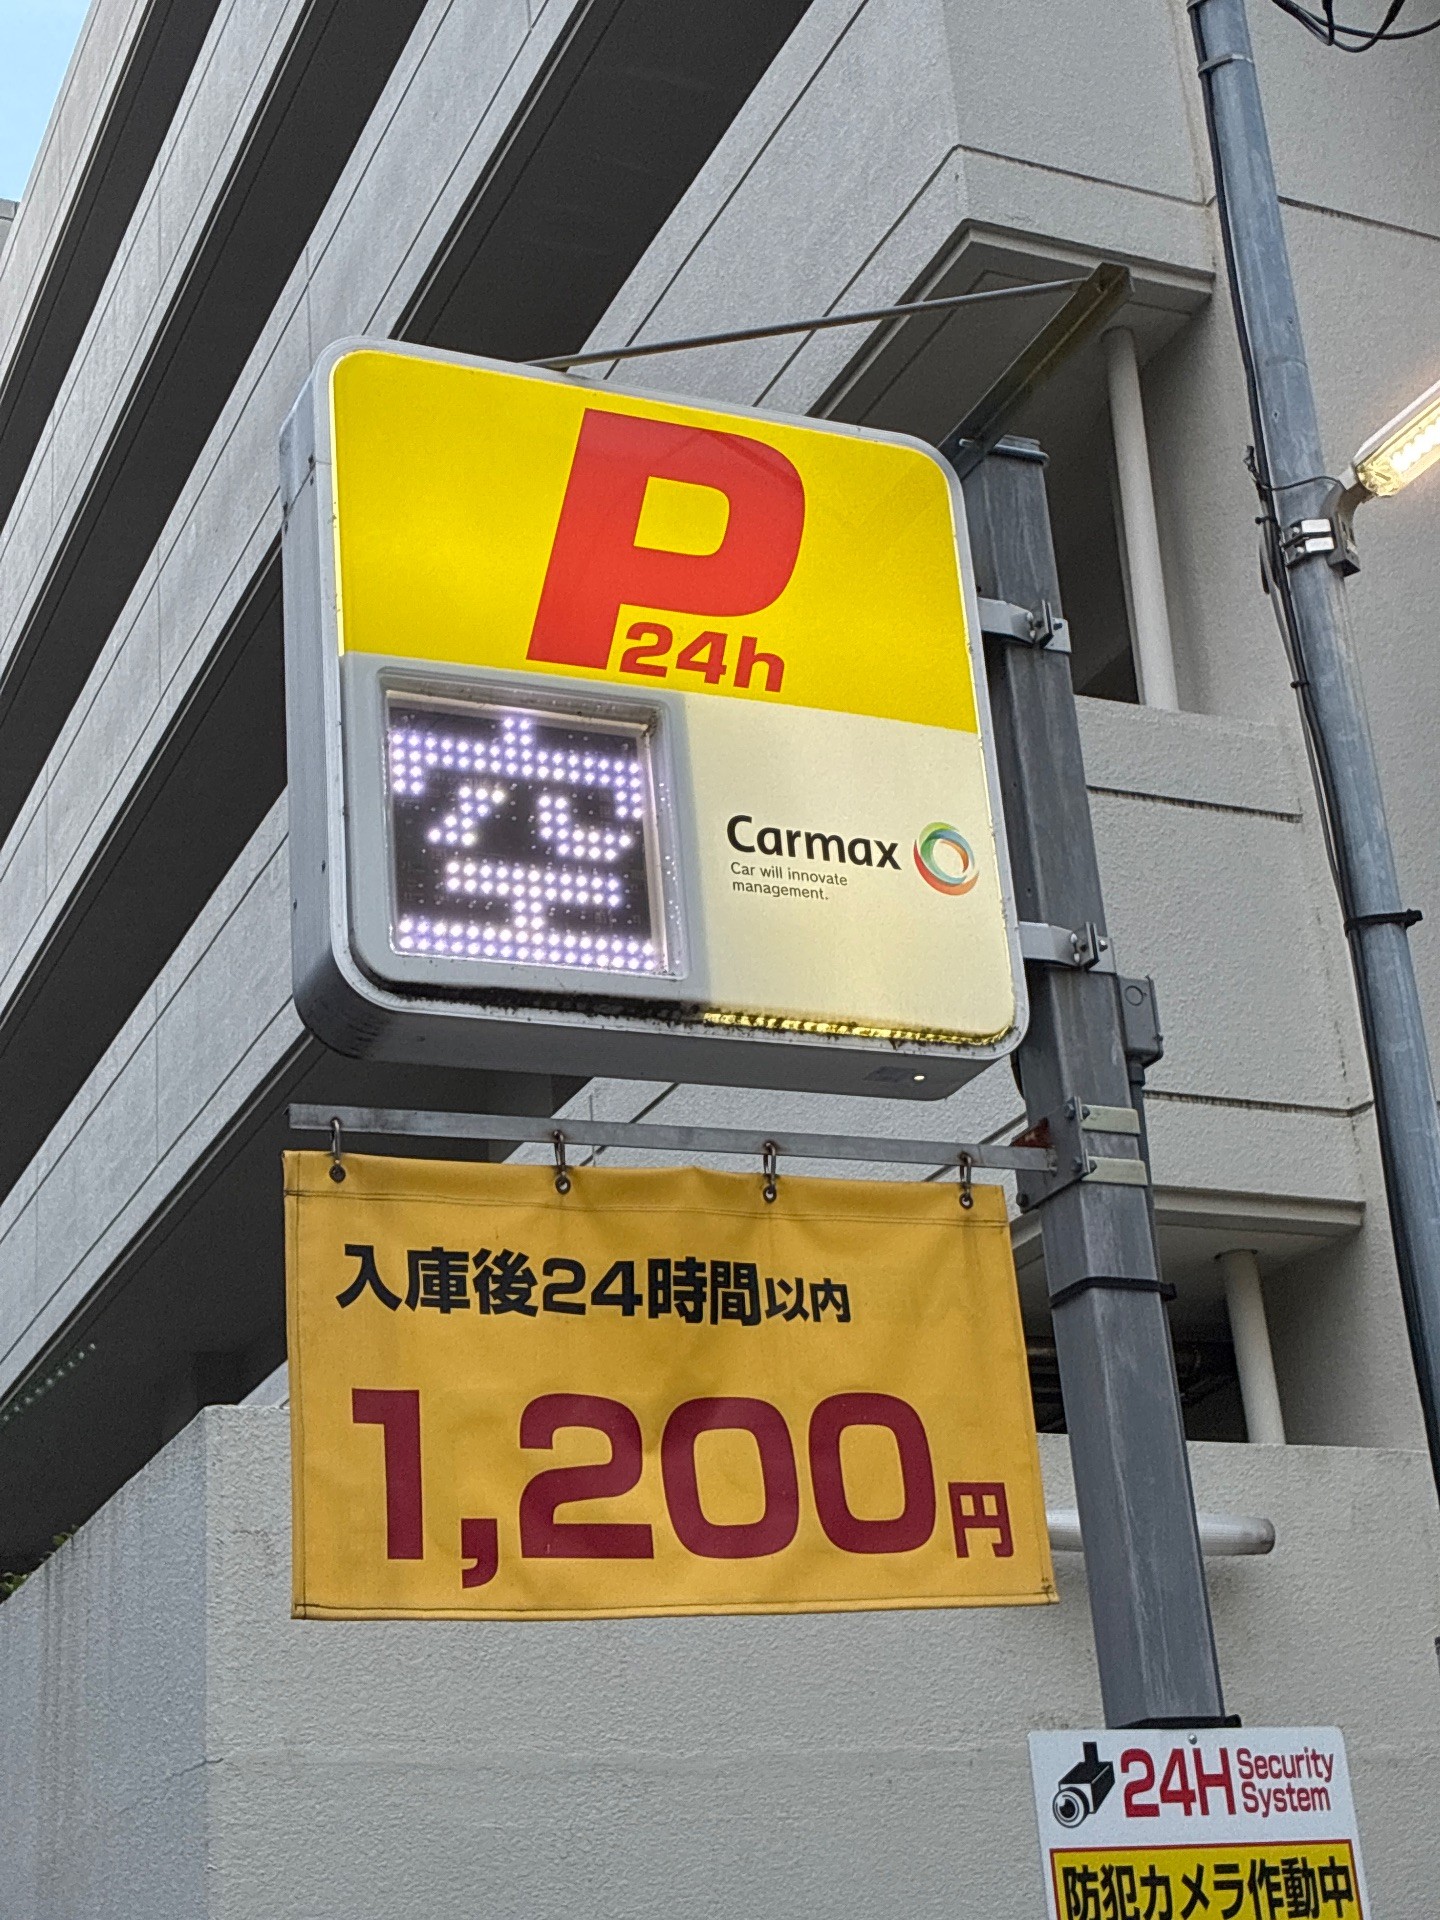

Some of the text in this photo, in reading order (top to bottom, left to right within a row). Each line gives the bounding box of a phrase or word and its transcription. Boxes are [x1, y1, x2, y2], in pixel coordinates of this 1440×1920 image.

[526, 407, 805, 670] P
[619, 621, 785, 692] 24h
[388, 716, 656, 969] 空
[727, 814, 902, 870] Carmax
[731, 862, 848, 886] Car will innovate
[732, 881, 829, 900] management.
[335, 1243, 852, 1326] 入庫後24時間以内
[1120, 1747, 1237, 1818] 24H
[1236, 1746, 1334, 1782] Security
[1242, 1781, 1332, 1818] System
[1062, 1855, 1354, 1920] 防犯カメラ作動中
